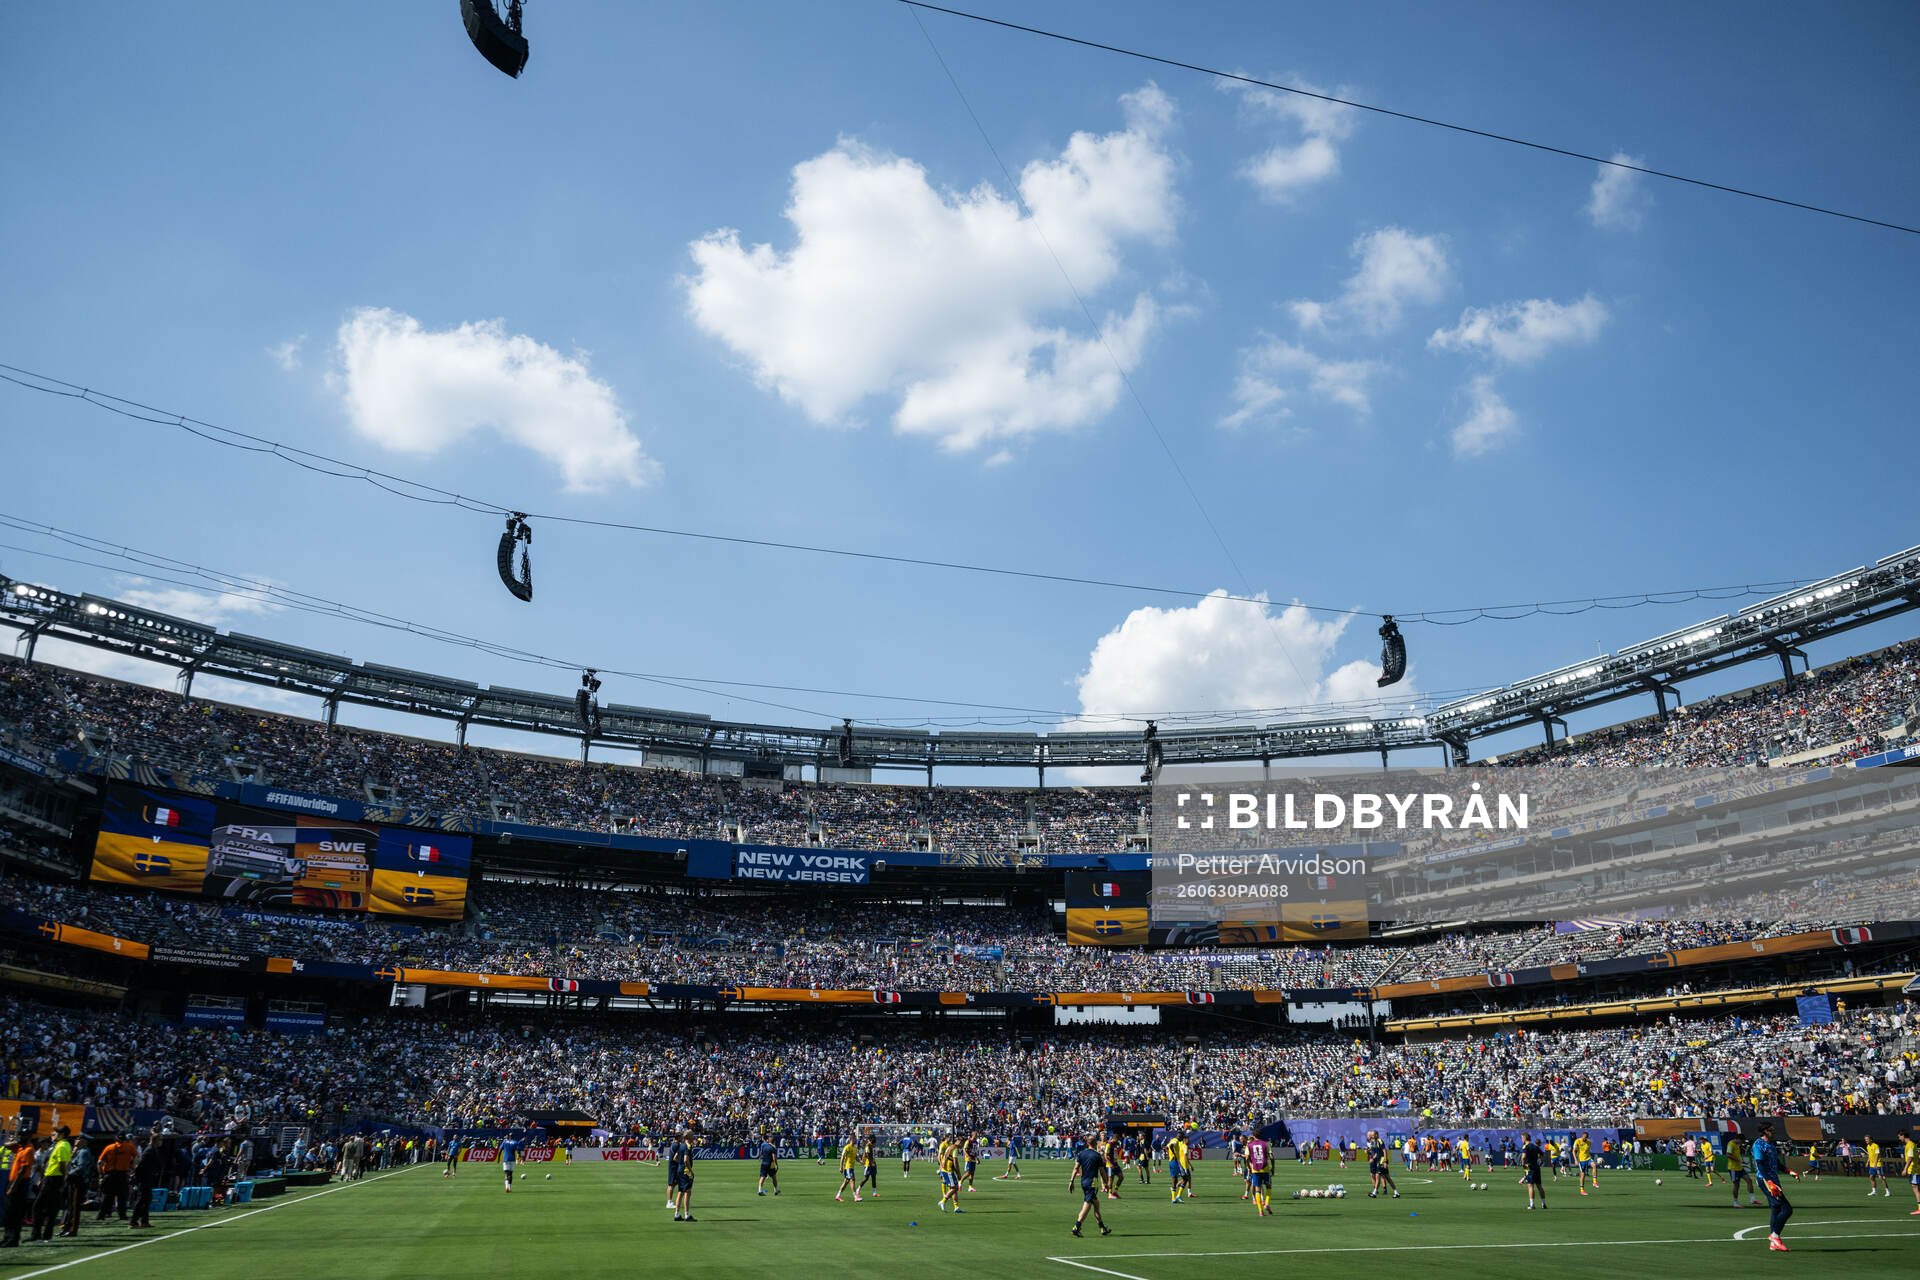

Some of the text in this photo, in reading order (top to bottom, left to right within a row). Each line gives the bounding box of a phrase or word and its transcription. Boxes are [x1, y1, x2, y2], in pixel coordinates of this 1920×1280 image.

[266, 792, 338, 814] #FIFAWorldCup
[226, 824, 274, 844] FRA
[227, 840, 283, 855] ATTACKING
[319, 841, 366, 853] SWE
[1429, 838, 1520, 862] NEW YORK NEW JERSEY
[739, 852, 865, 870] NEW YORK
[1146, 857, 1170, 867] FIFA
[738, 867, 865, 883] NEW JERSEY
[1190, 955, 1216, 963] WORLD
[467, 1148, 495, 1162] Lay's
[525, 1148, 552, 1161] Lay's
[601, 1147, 656, 1161] veizon
[692, 1146, 795, 1160] Michelob URA
[1022, 1146, 1078, 1160] Hise
